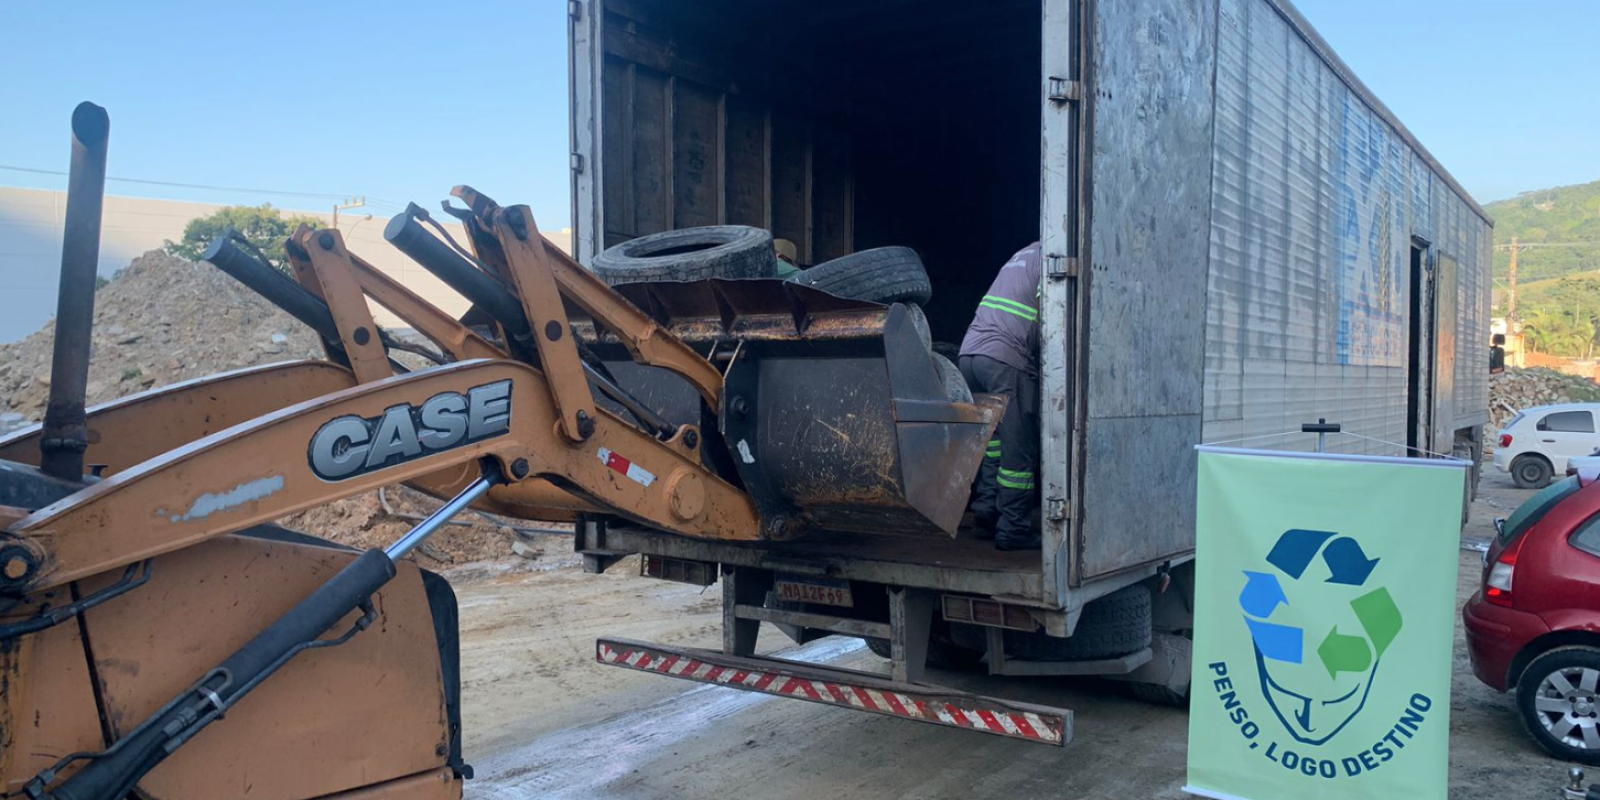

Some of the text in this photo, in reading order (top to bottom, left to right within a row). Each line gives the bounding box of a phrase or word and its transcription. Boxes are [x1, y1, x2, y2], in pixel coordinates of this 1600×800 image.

[310, 379, 512, 479] CASE
[1208, 661, 1433, 779] PENSO, LOGO DESTINO
